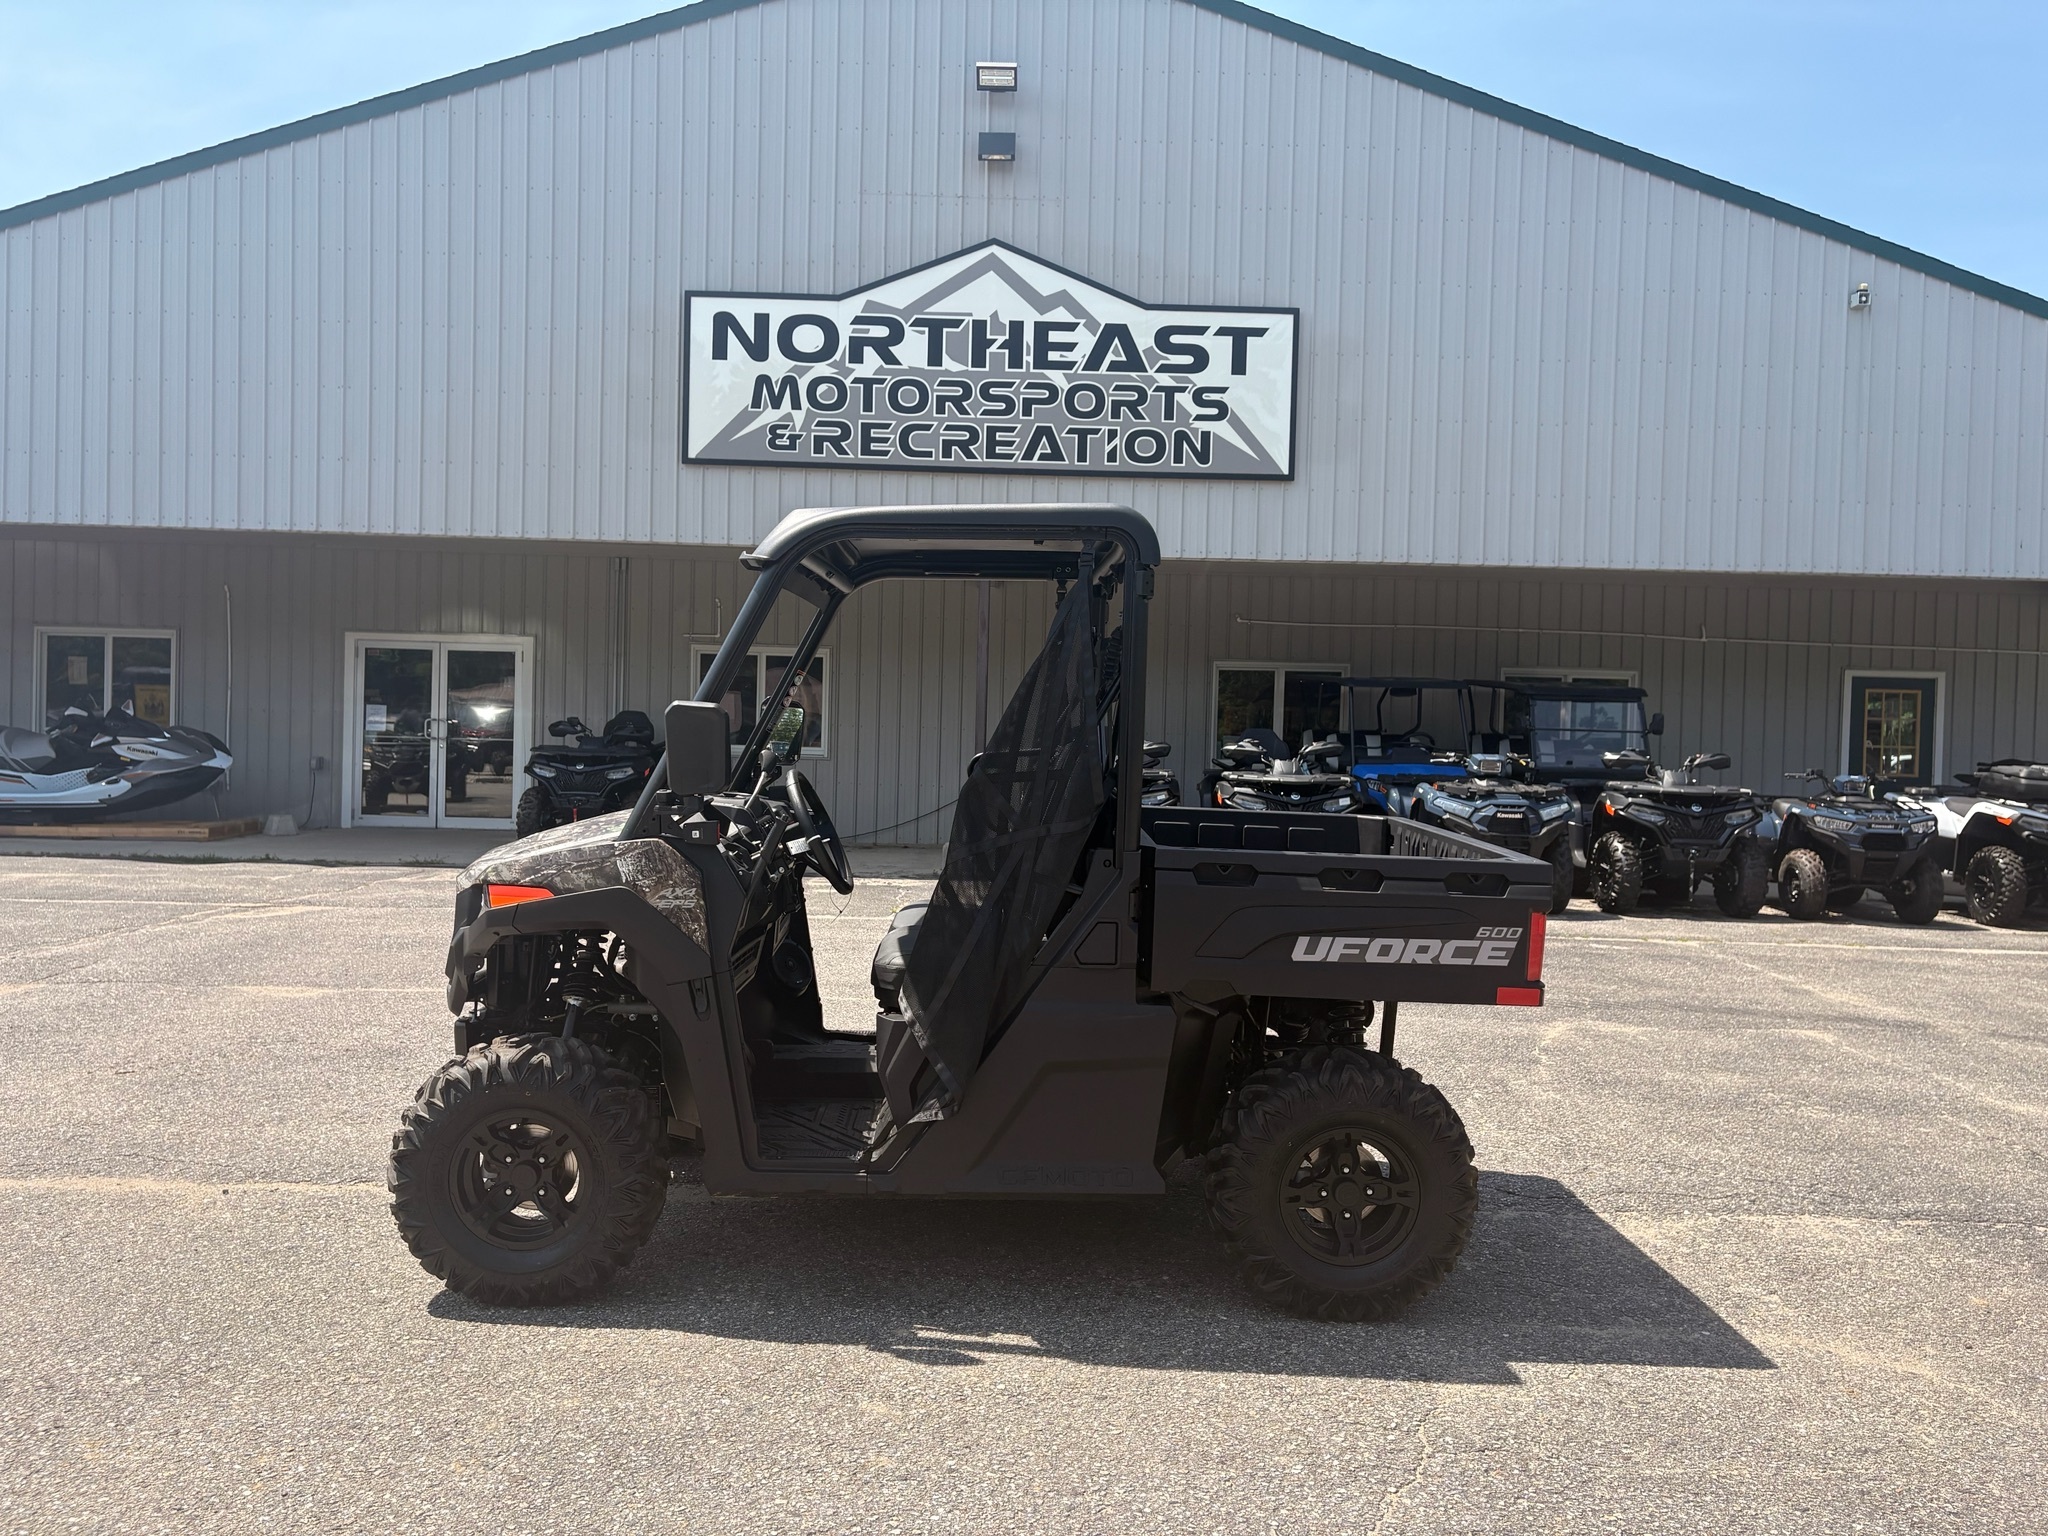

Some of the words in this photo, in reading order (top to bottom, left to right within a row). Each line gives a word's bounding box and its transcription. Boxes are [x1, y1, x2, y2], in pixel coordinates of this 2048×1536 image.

[711, 310, 1271, 376] NORTHEAST
[750, 374, 1230, 424] MOTORSPORTS
[126, 745, 159, 757] Kawasaki
[1496, 811, 1523, 819] Kawasaki
[660, 899, 698, 909] EPS
[1475, 926, 1523, 938] 600
[1291, 936, 1518, 967] UFORCE
